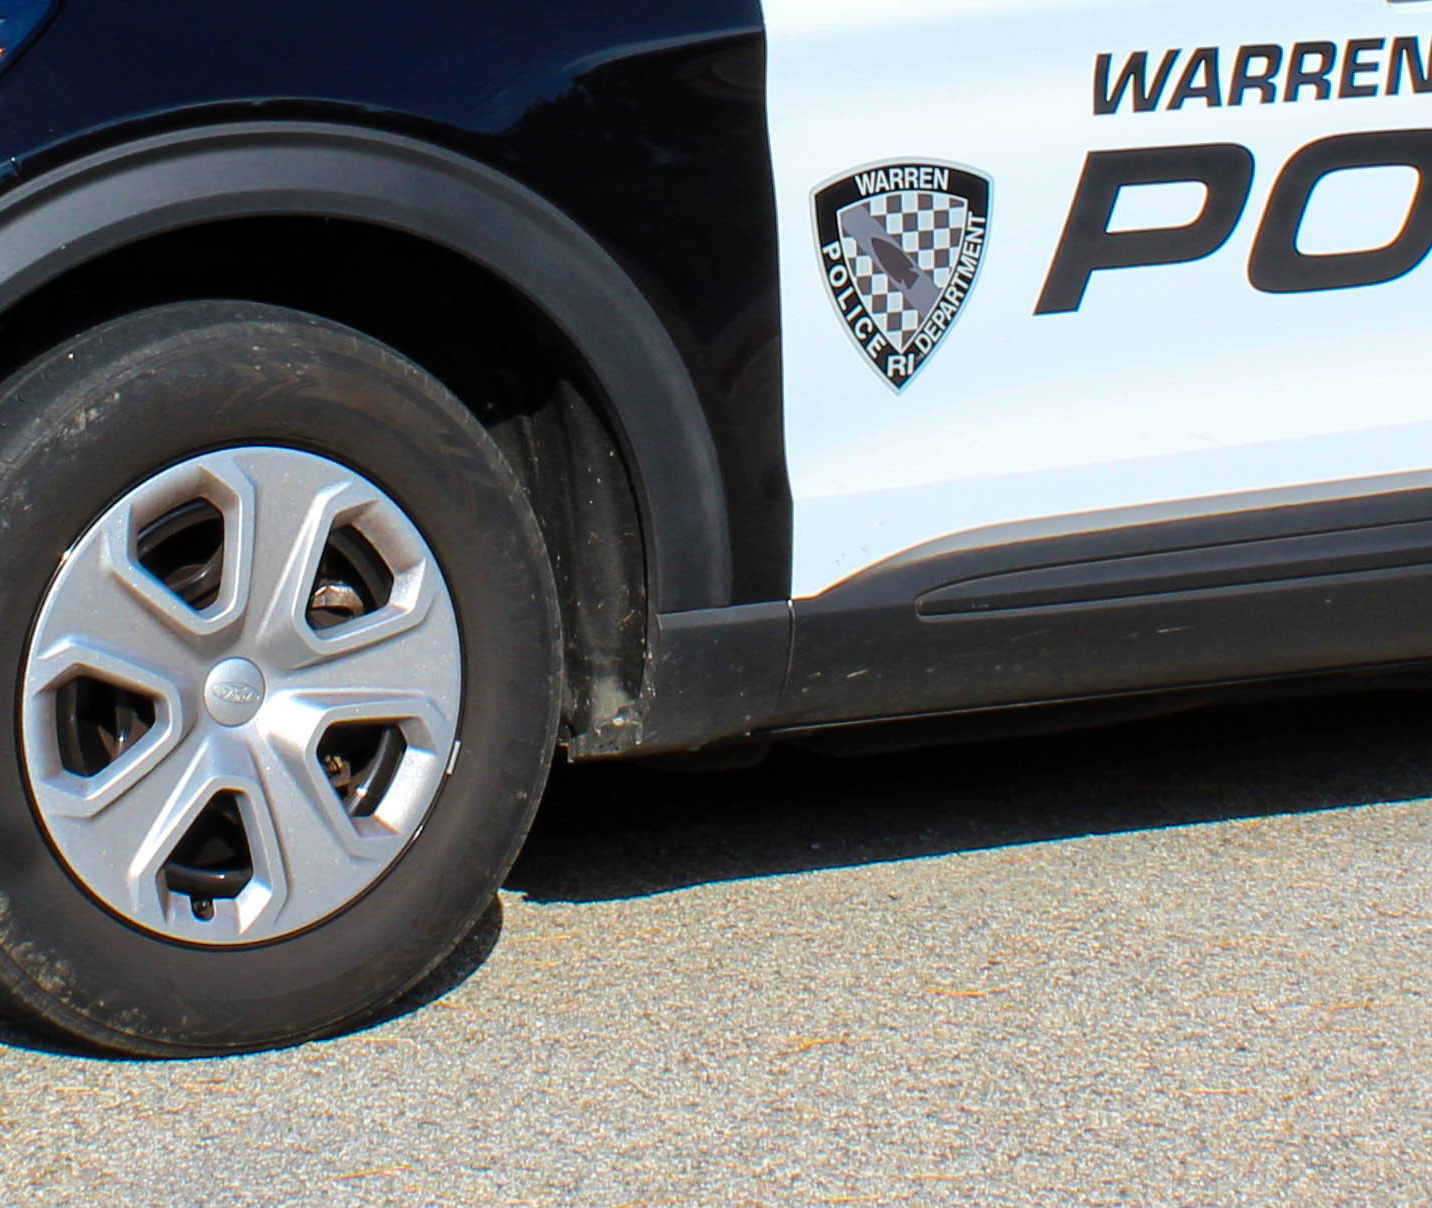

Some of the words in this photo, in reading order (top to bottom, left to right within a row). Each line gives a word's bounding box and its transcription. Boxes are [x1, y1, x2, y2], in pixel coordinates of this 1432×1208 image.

[855, 168, 949, 197] WARREN
[822, 242, 887, 359] POLICE
[914, 211, 987, 355] DEPARTMENT
[887, 353, 915, 378] RI
